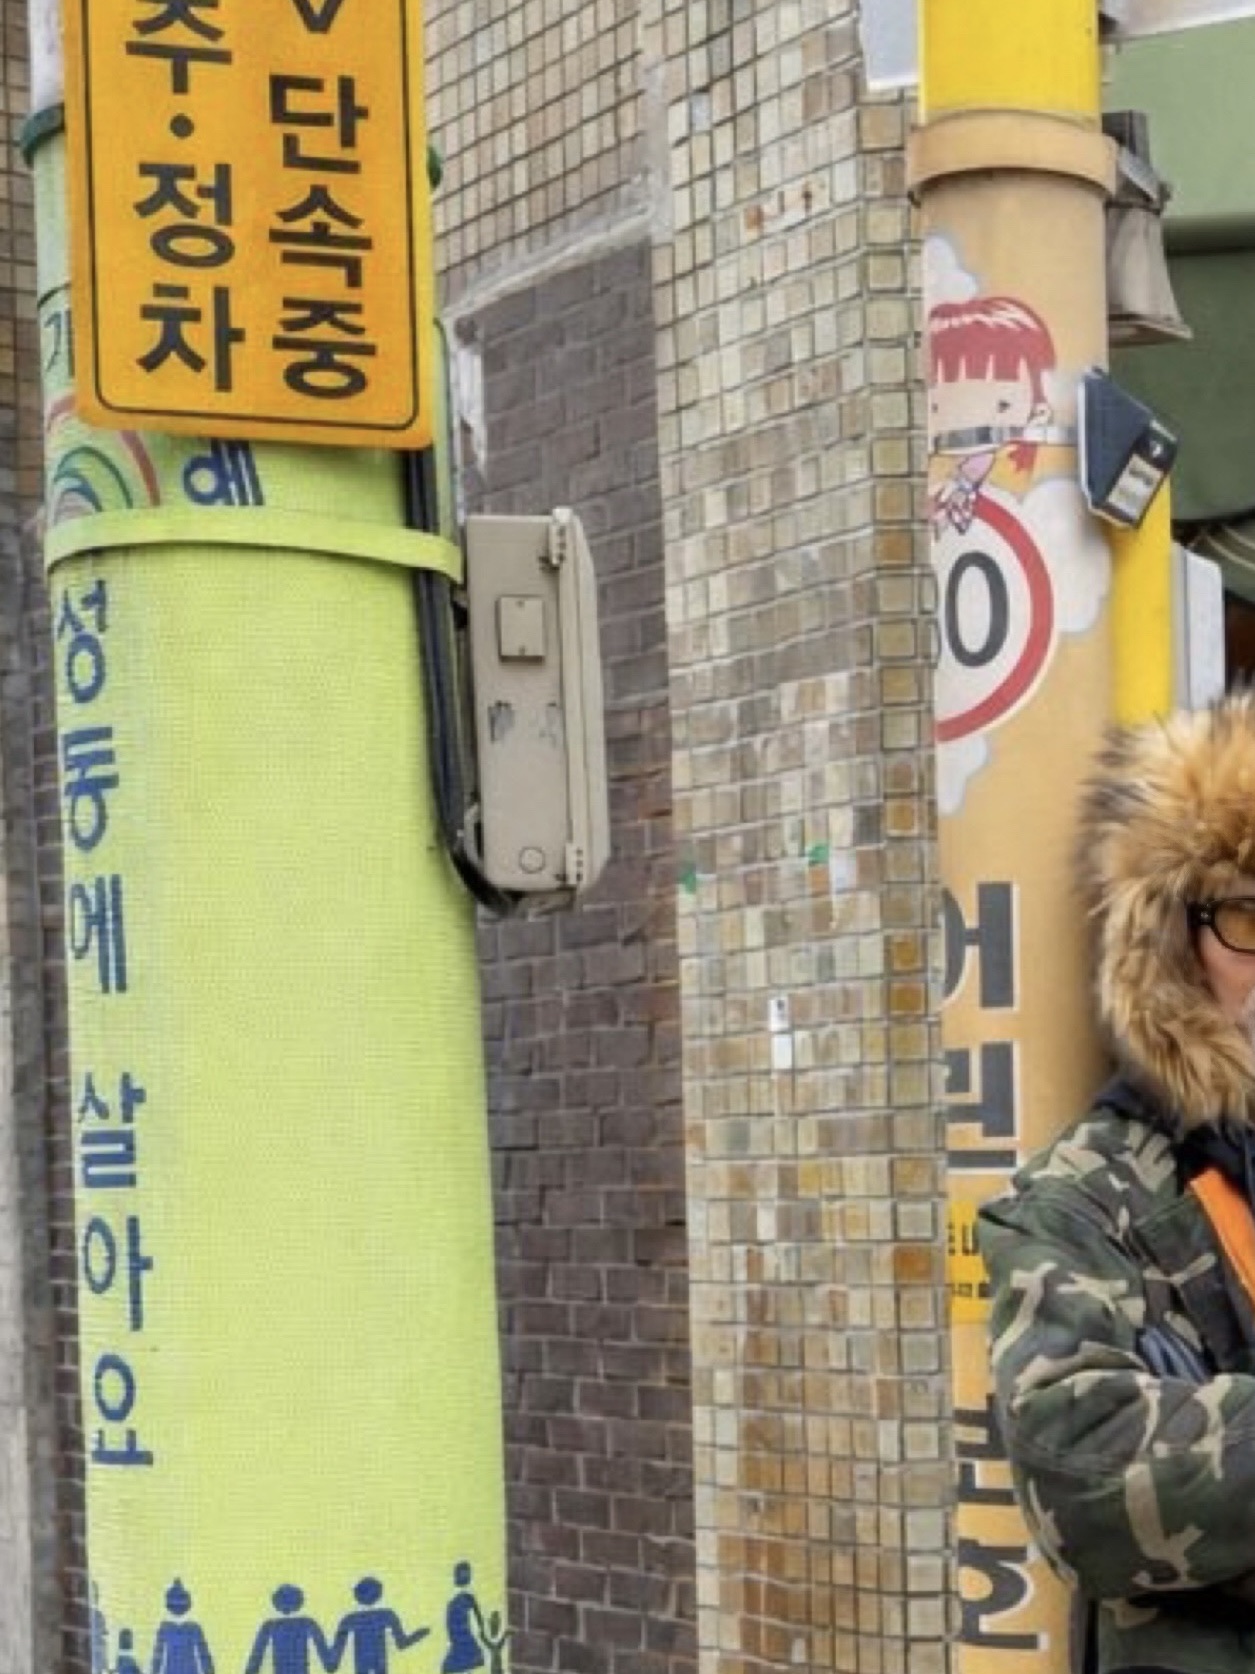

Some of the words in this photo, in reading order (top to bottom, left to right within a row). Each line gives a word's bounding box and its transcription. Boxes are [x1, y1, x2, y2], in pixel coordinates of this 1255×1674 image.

[268, 73, 378, 400] 단속중
[57, 579, 127, 994] 성동에
[77, 1071, 154, 1466] 살아요
